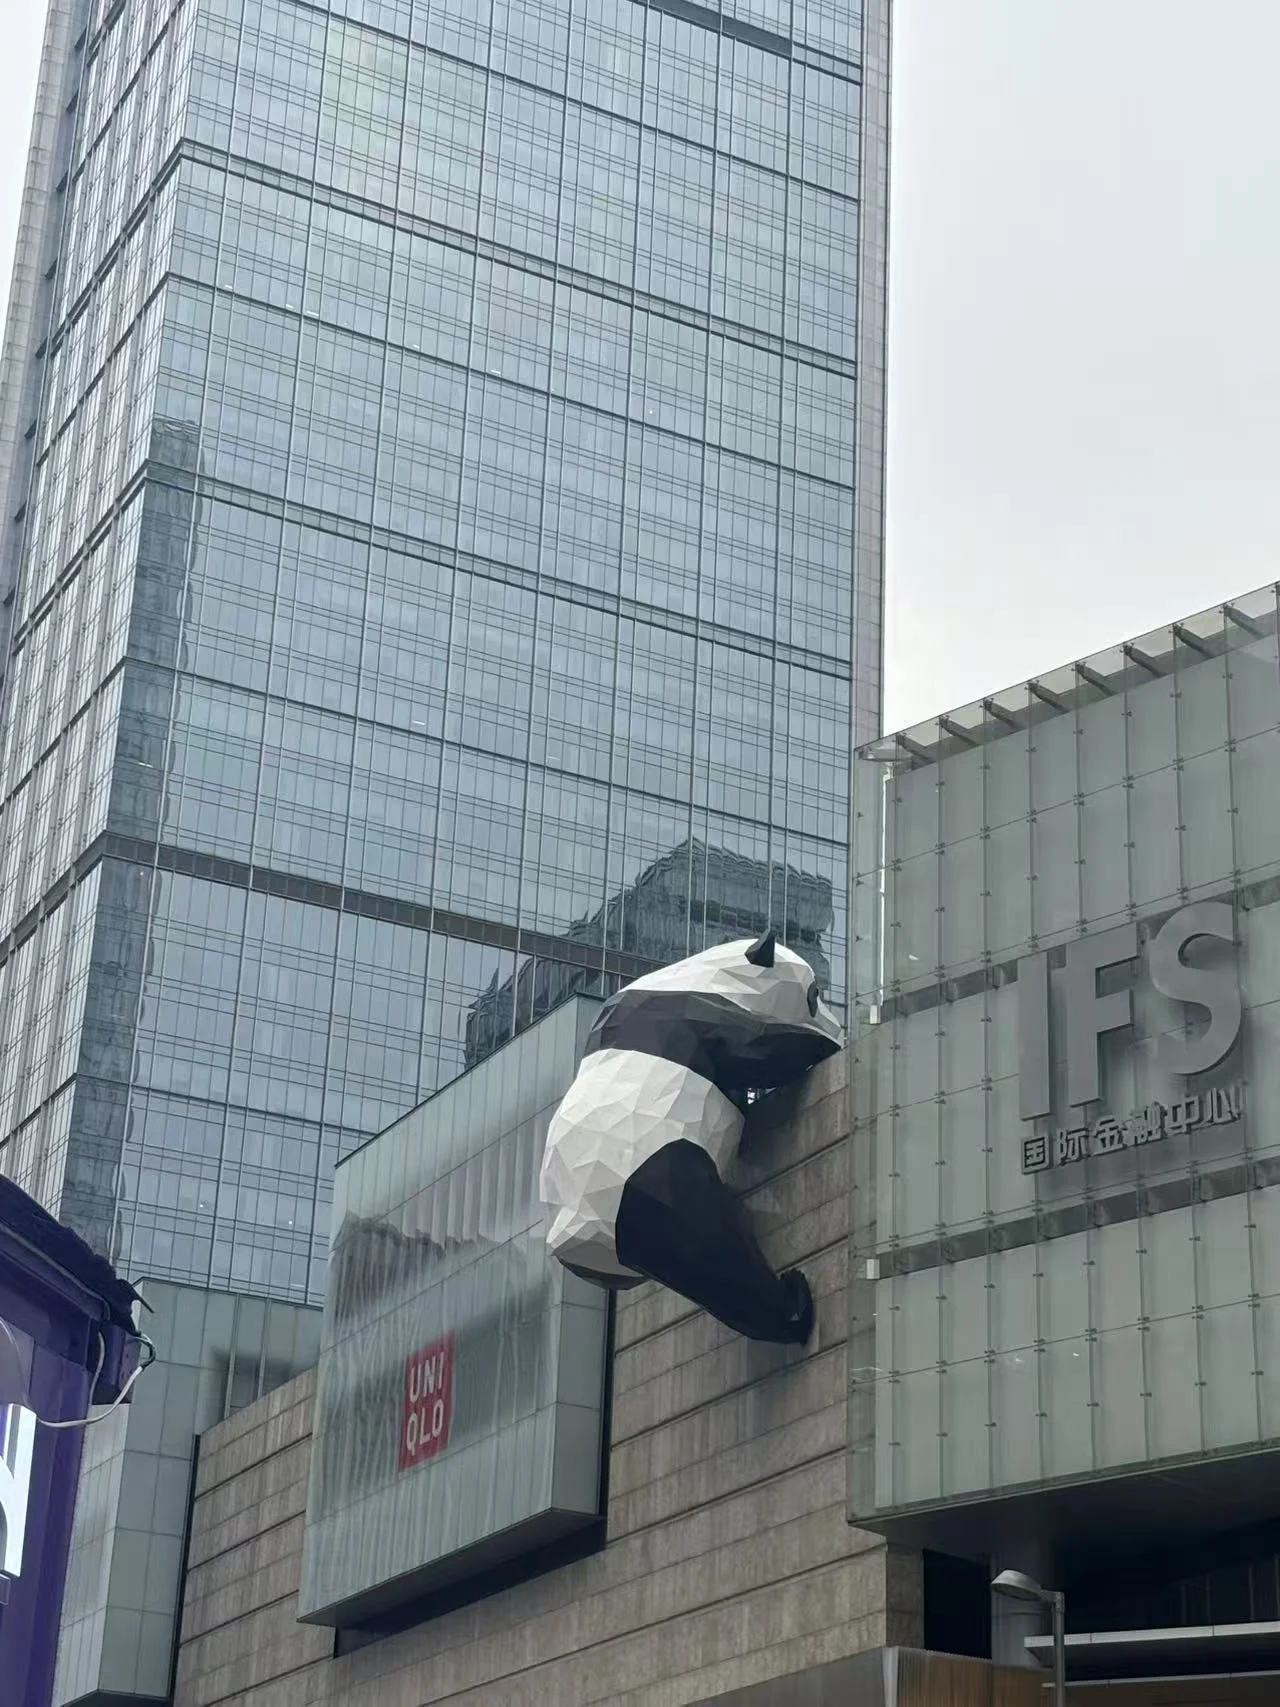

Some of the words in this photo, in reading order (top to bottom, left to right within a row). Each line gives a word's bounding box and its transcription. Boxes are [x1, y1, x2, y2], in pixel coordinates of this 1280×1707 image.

[1017, 901, 1243, 1121] IFS
[1021, 1085, 1244, 1175] 国际金融中心
[409, 1351, 444, 1403] UNI
[406, 1399, 444, 1456] QLO
